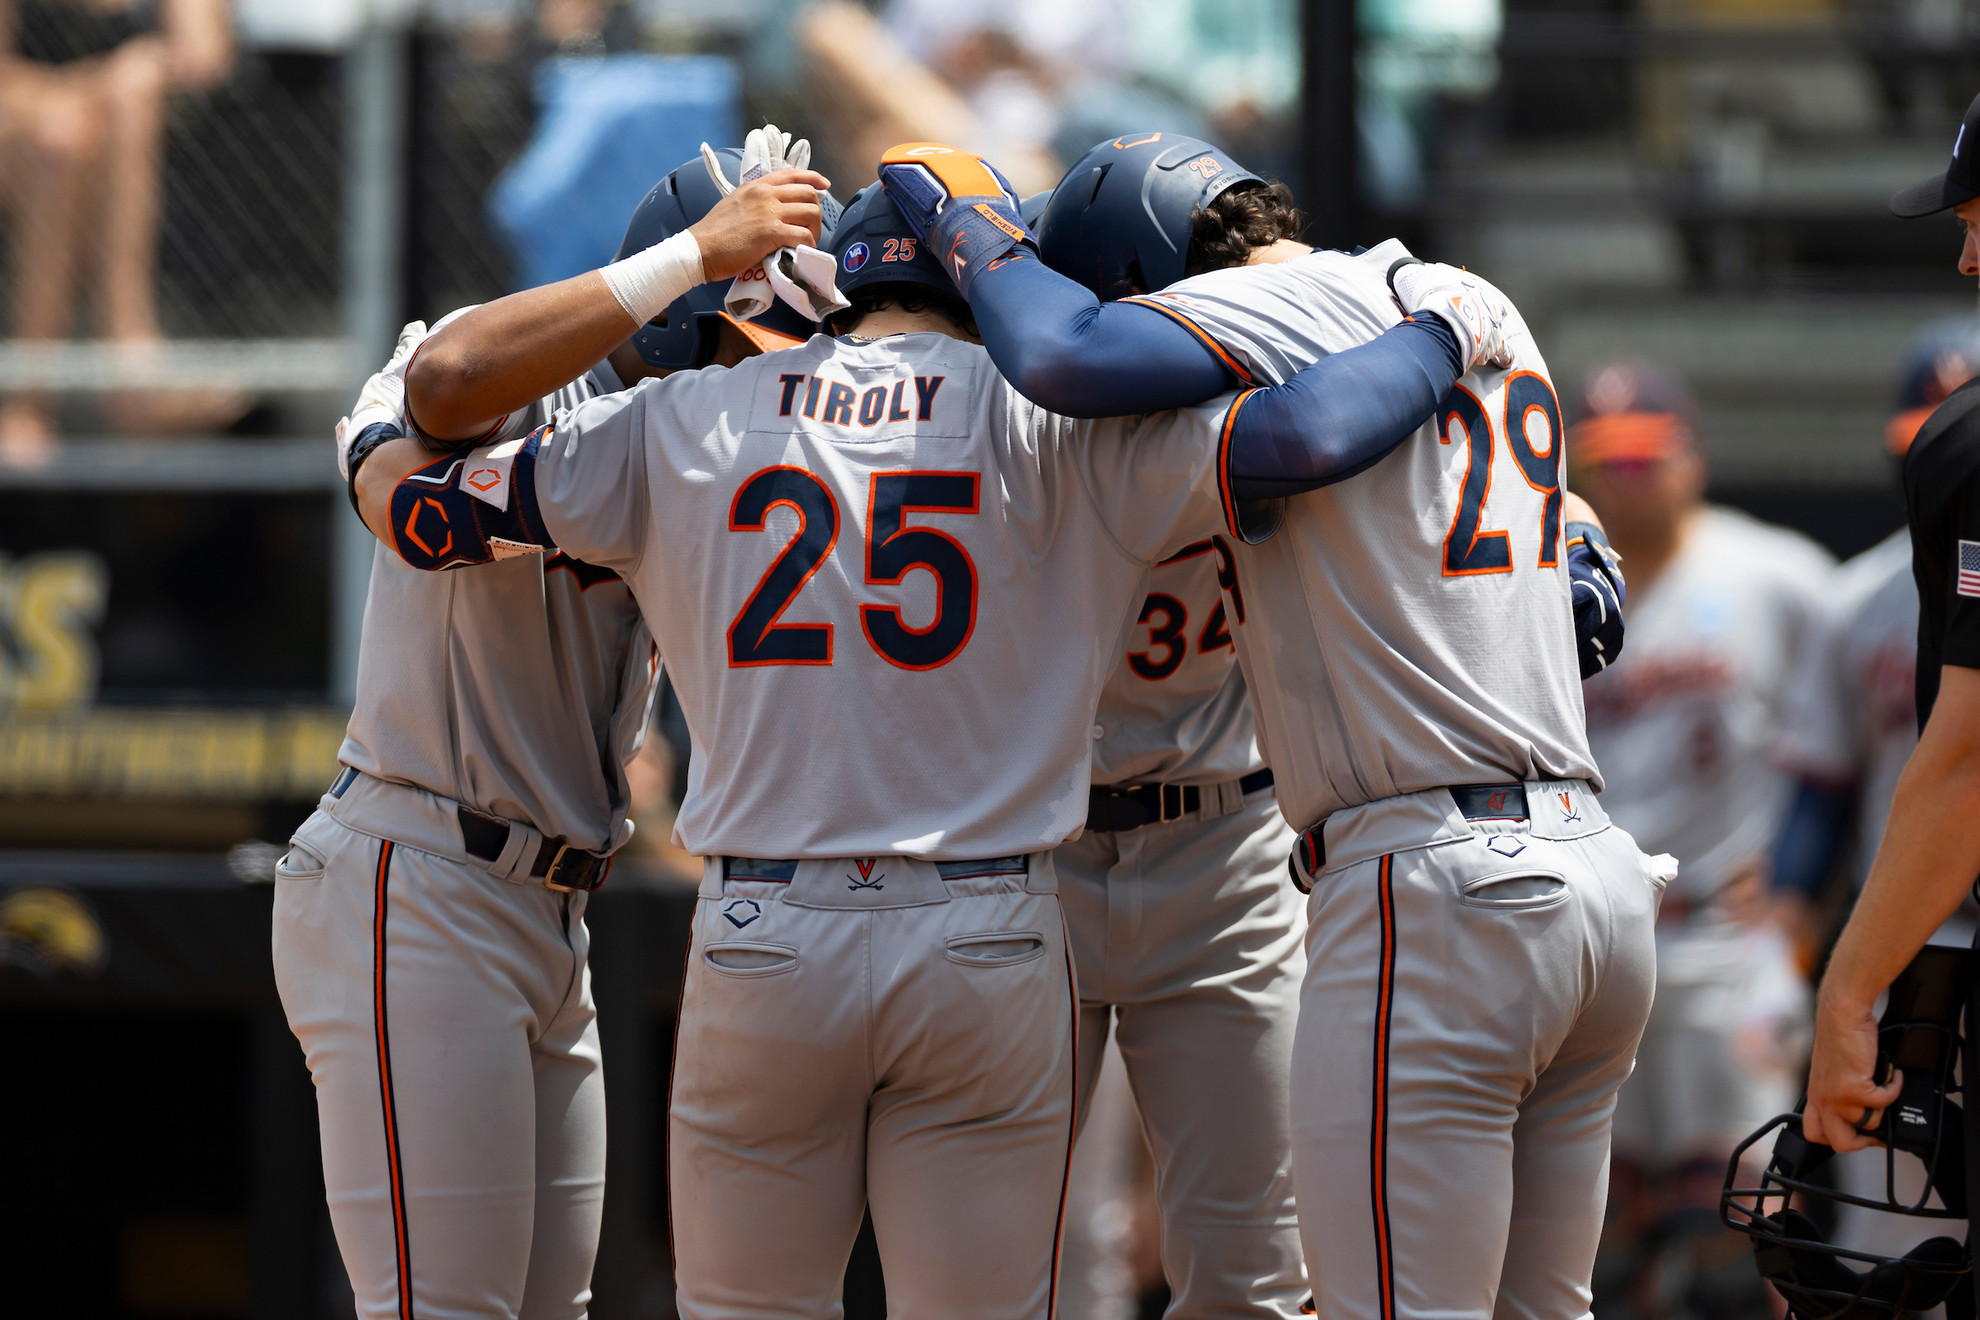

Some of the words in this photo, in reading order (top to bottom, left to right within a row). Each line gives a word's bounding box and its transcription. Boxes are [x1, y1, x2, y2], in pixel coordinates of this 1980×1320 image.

[1189, 156, 1223, 180] 29
[882, 238, 917, 262] 25
[778, 373, 946, 428] TIROLY
[1436, 369, 1564, 577] 29
[726, 464, 981, 672] 25
[1126, 592, 1236, 682] 34
